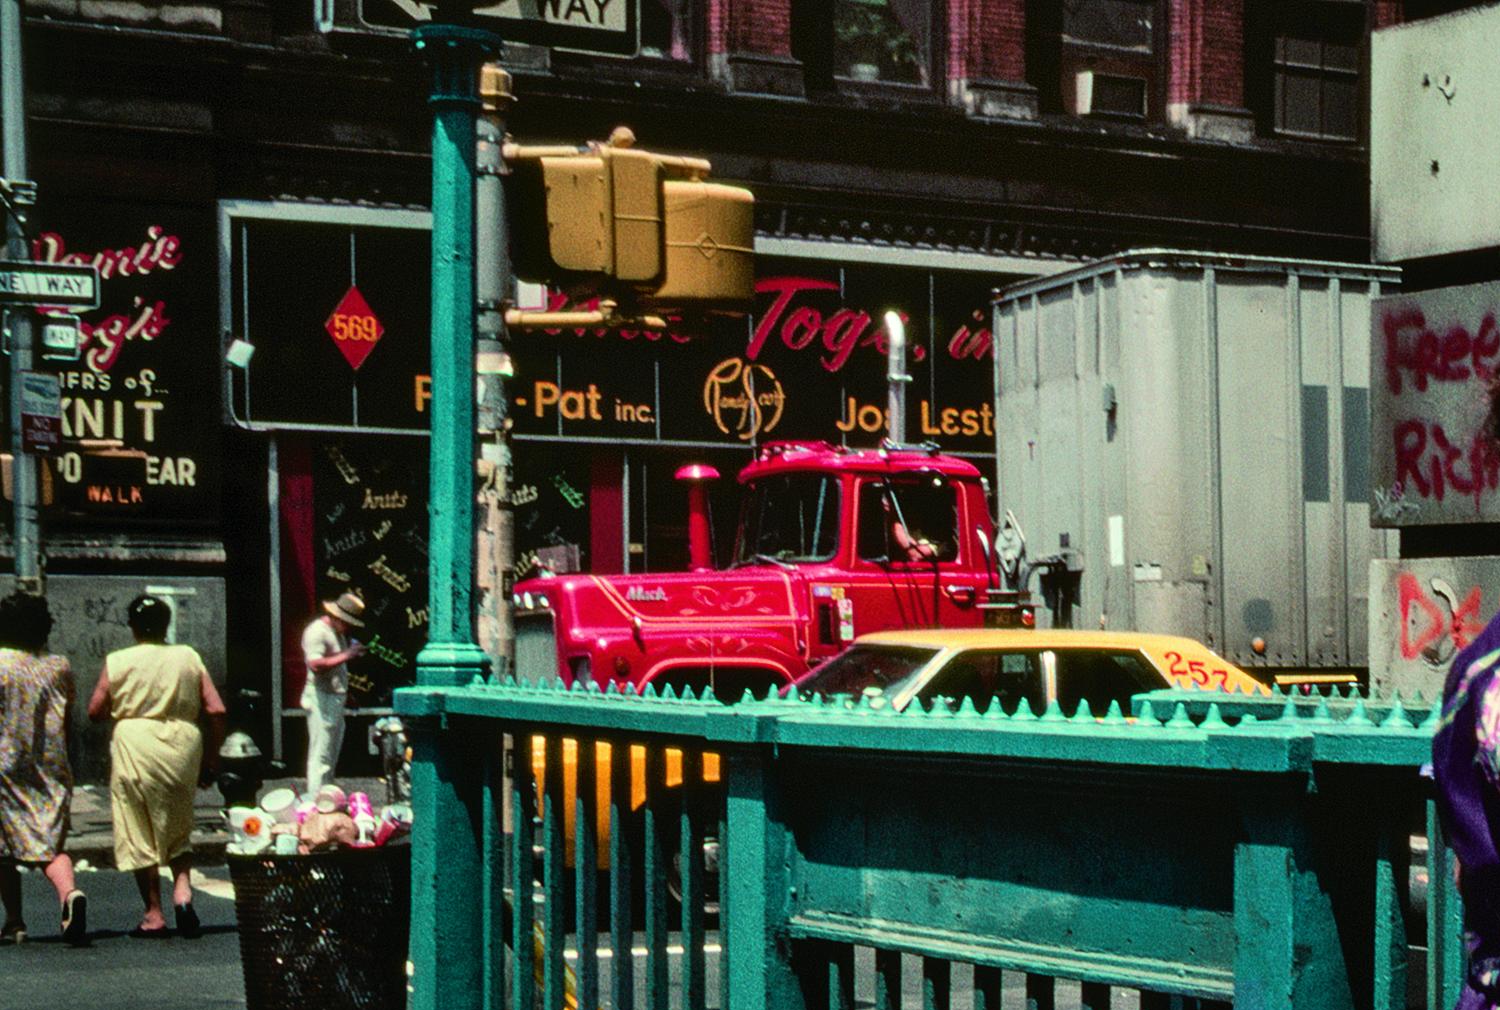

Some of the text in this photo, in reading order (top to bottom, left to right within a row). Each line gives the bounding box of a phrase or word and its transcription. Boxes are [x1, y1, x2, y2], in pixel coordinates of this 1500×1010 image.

[0, 272, 84, 294] NE WAY
[333, 313, 378, 342] 569
[60, 396, 165, 442] KNIT
[615, 398, 656, 424] inc.
[87, 485, 143, 504] WALK
